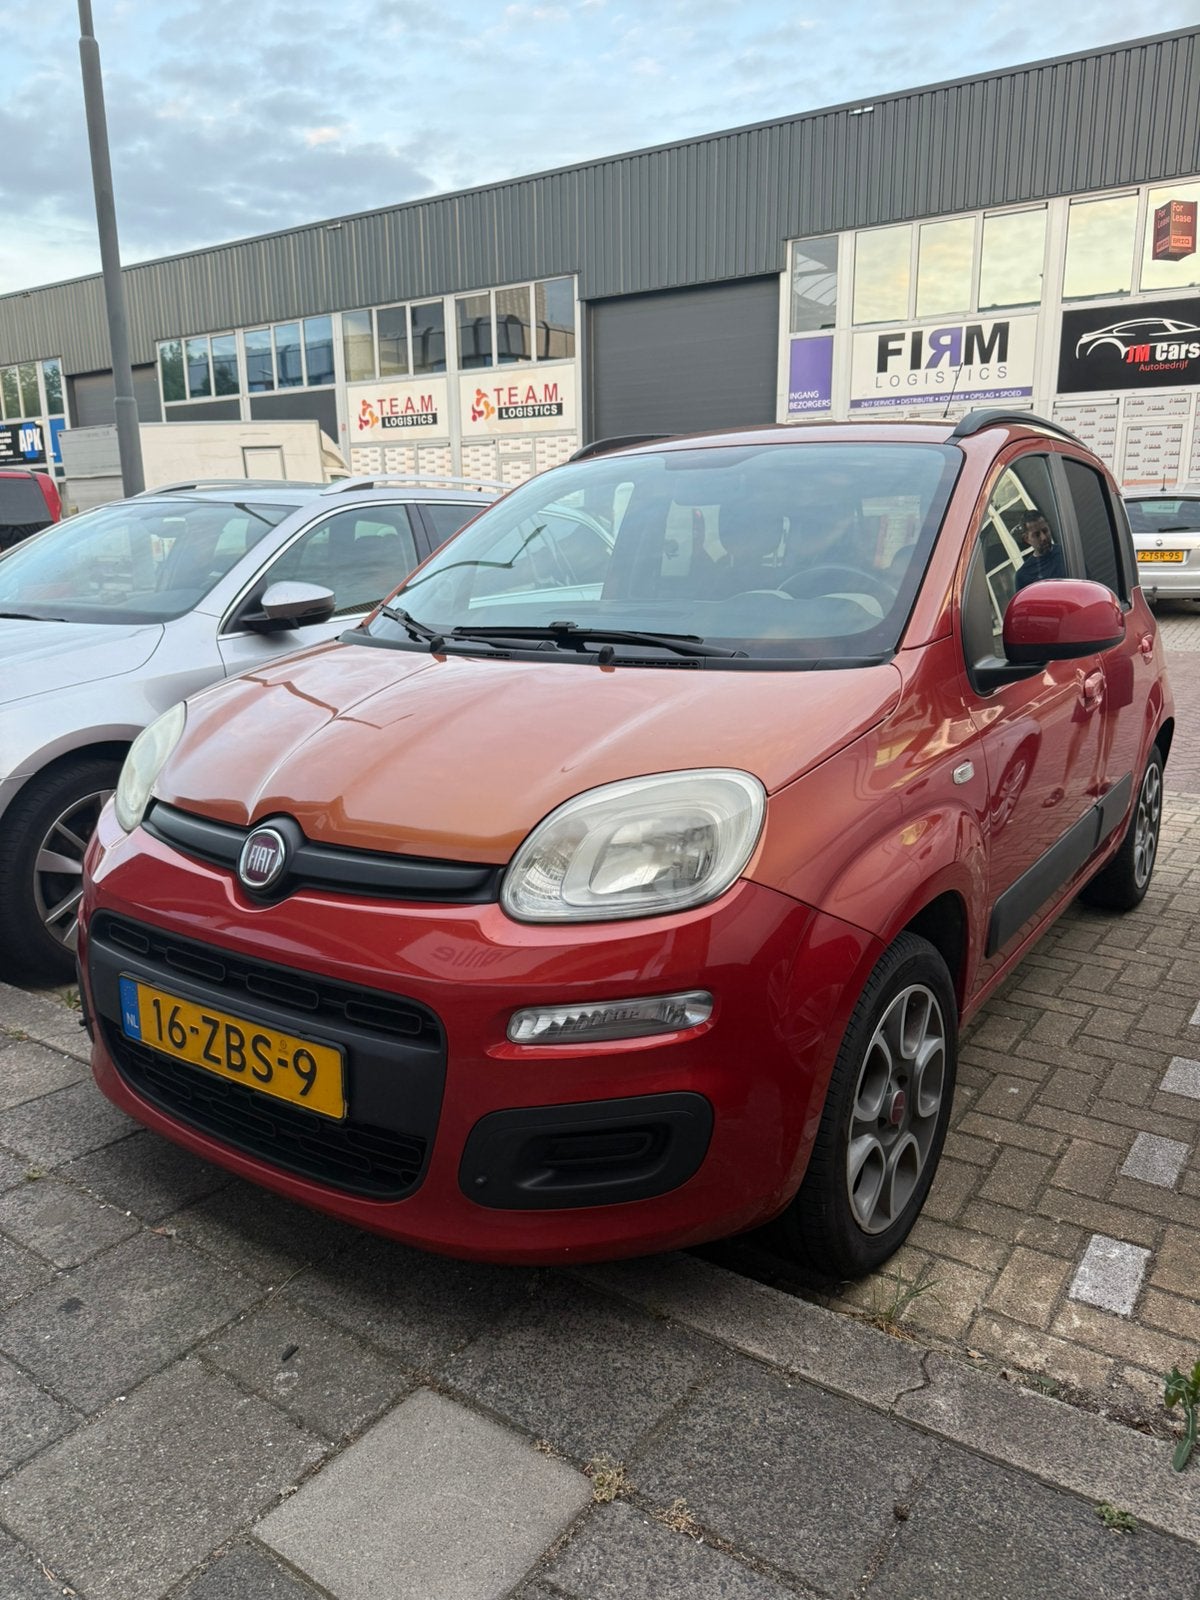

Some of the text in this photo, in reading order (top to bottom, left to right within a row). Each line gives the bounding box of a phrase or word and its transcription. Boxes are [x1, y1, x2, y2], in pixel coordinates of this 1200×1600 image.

[1172, 202, 1184, 212] For
[1172, 213, 1192, 223] Lease
[877, 321, 1010, 374] FIRM
[1126, 342, 1200, 363] JM Cars
[1138, 360, 1189, 372] Autobedrijf
[876, 366, 1007, 388] LOGISTICS
[493, 383, 564, 407] T.E.A.M.
[789, 390, 819, 400] INGANG
[873, 399, 896, 407] SERVICE
[970, 391, 995, 400] OPSLAG
[1000, 390, 1022, 398] SPOED
[377, 394, 438, 416] T.E.A.M.
[501, 405, 559, 419] LOGISTICS
[789, 400, 831, 409] BEZORGERS
[385, 414, 434, 428] LOGISTICS
[19, 428, 43, 452] APK
[1140, 552, 1181, 560] 2-TSR-95
[247, 844, 276, 874] FIAT
[125, 1012, 140, 1029] NL
[152, 998, 317, 1096] 16-ZBS-9
